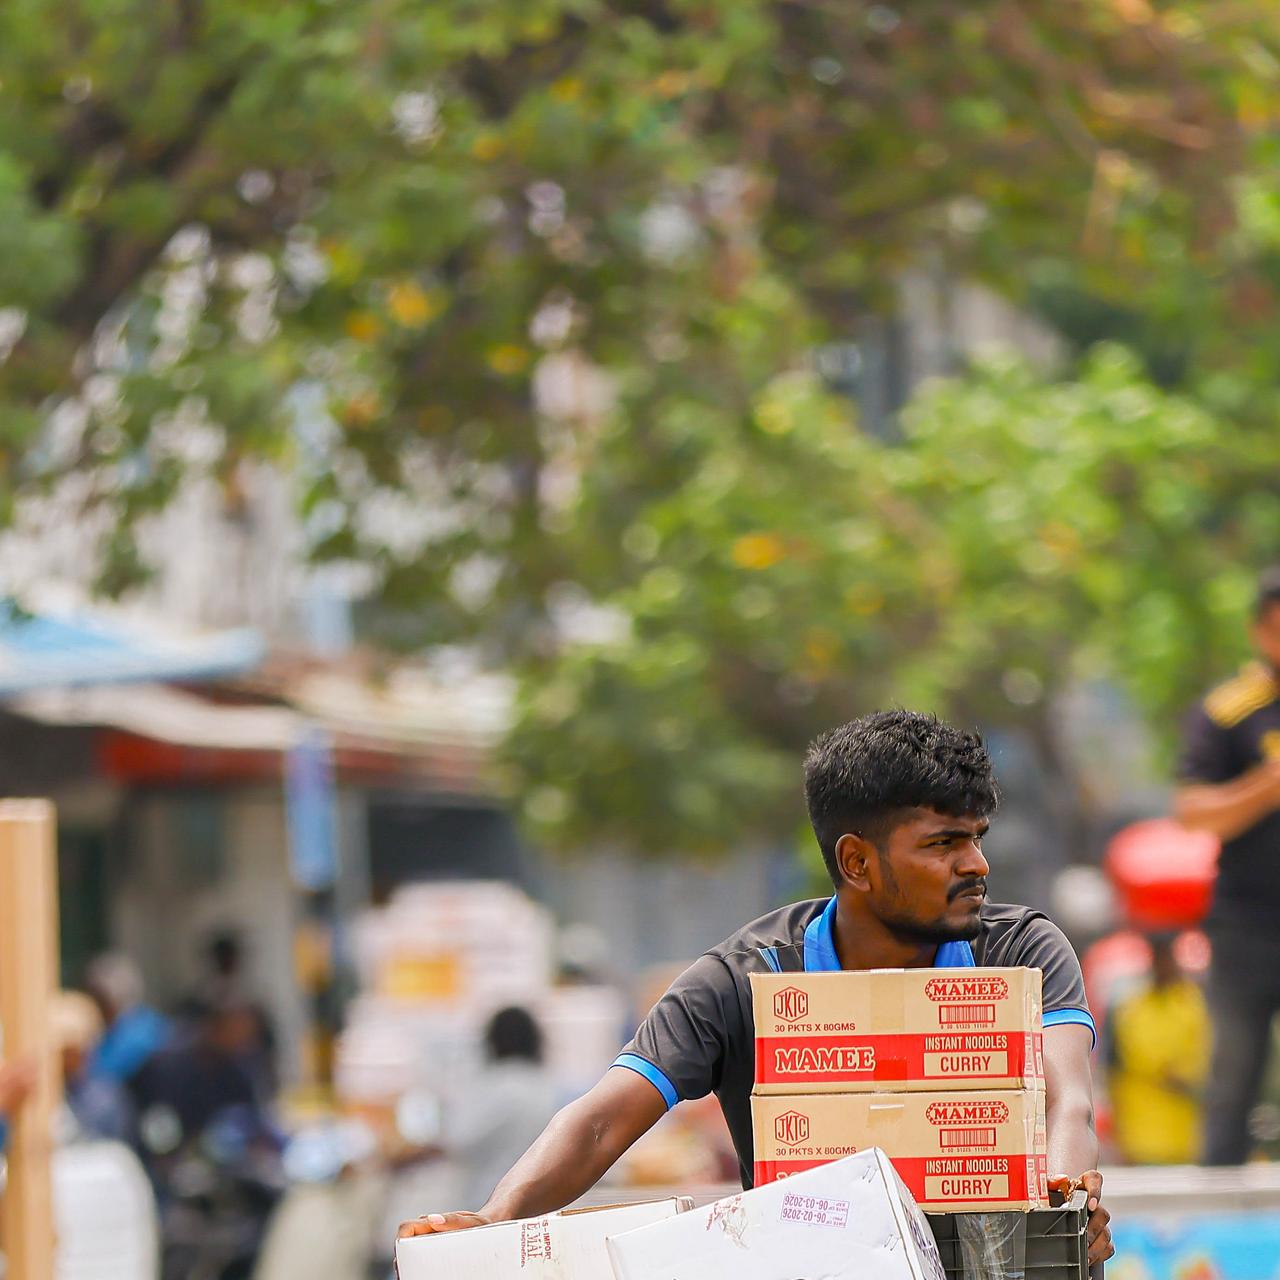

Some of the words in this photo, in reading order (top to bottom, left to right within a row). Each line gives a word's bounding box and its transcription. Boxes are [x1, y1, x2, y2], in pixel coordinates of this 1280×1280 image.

[933, 982, 1001, 996] MAMEE
[777, 991, 806, 1019] JKTC
[787, 1024, 813, 1032] PKTS
[823, 1023, 856, 1032] 80GMS
[925, 1036, 963, 1050] INSTANT
[965, 1035, 1008, 1049] NOODLES
[775, 1047, 876, 1073] MAMEE
[940, 1056, 991, 1072] CURRY
[934, 1106, 1002, 1120] MAMEE
[778, 1114, 807, 1142] JKTC
[788, 1147, 814, 1155] PKTS
[926, 1160, 964, 1173] INSTANT
[965, 1159, 1008, 1172] NOODLES
[941, 1179, 992, 1195] CURRY
